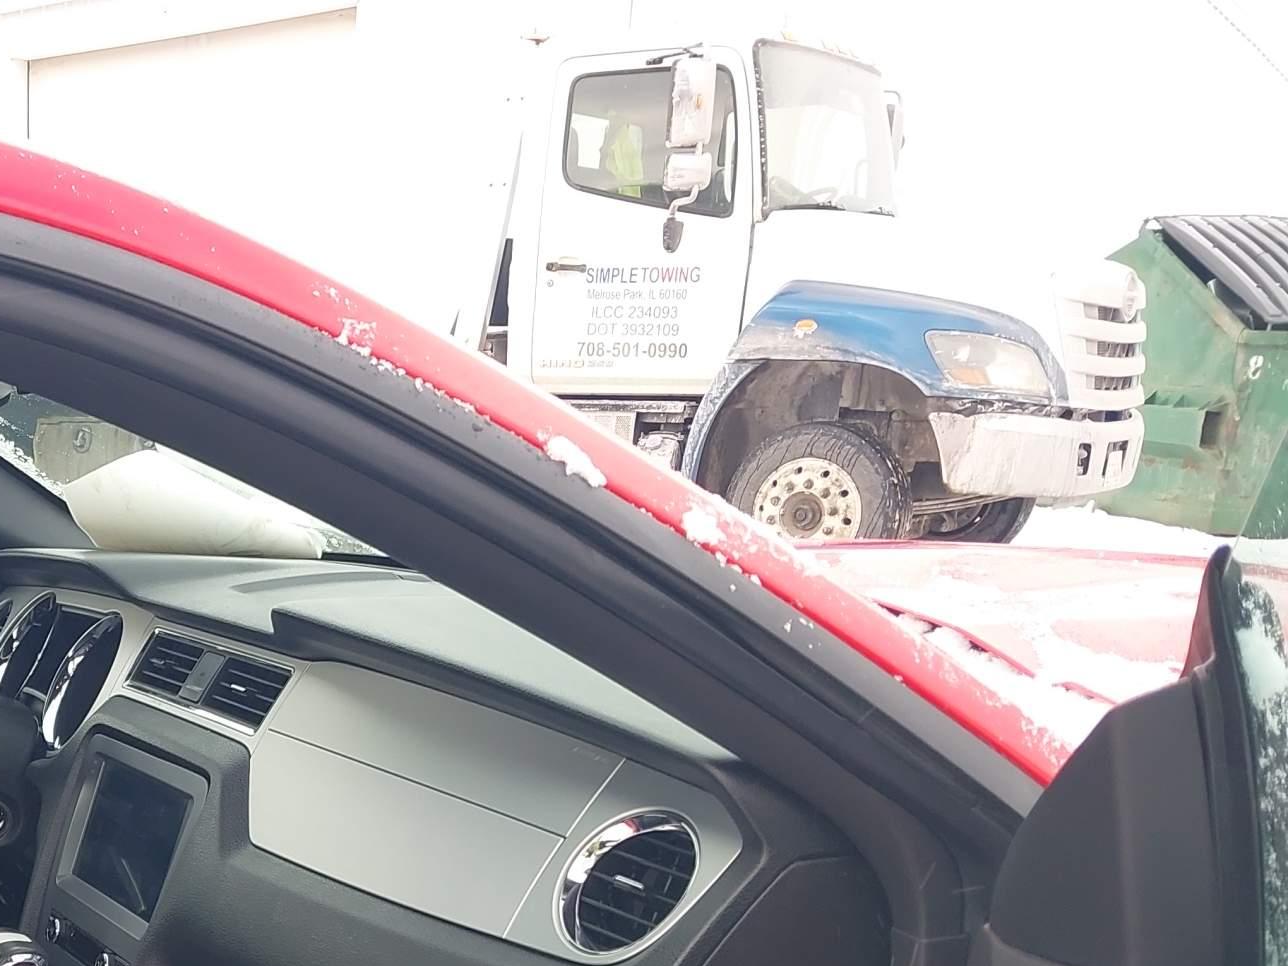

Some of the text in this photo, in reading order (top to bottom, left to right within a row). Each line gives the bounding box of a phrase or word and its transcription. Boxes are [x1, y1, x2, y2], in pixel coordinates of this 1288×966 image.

[587, 288, 621, 300] Melrose
[659, 288, 688, 300] 60160
[591, 305, 679, 319] ILCC 234093
[586, 322, 680, 337] DOT 3932109
[577, 341, 688, 359] 708-501-0990
